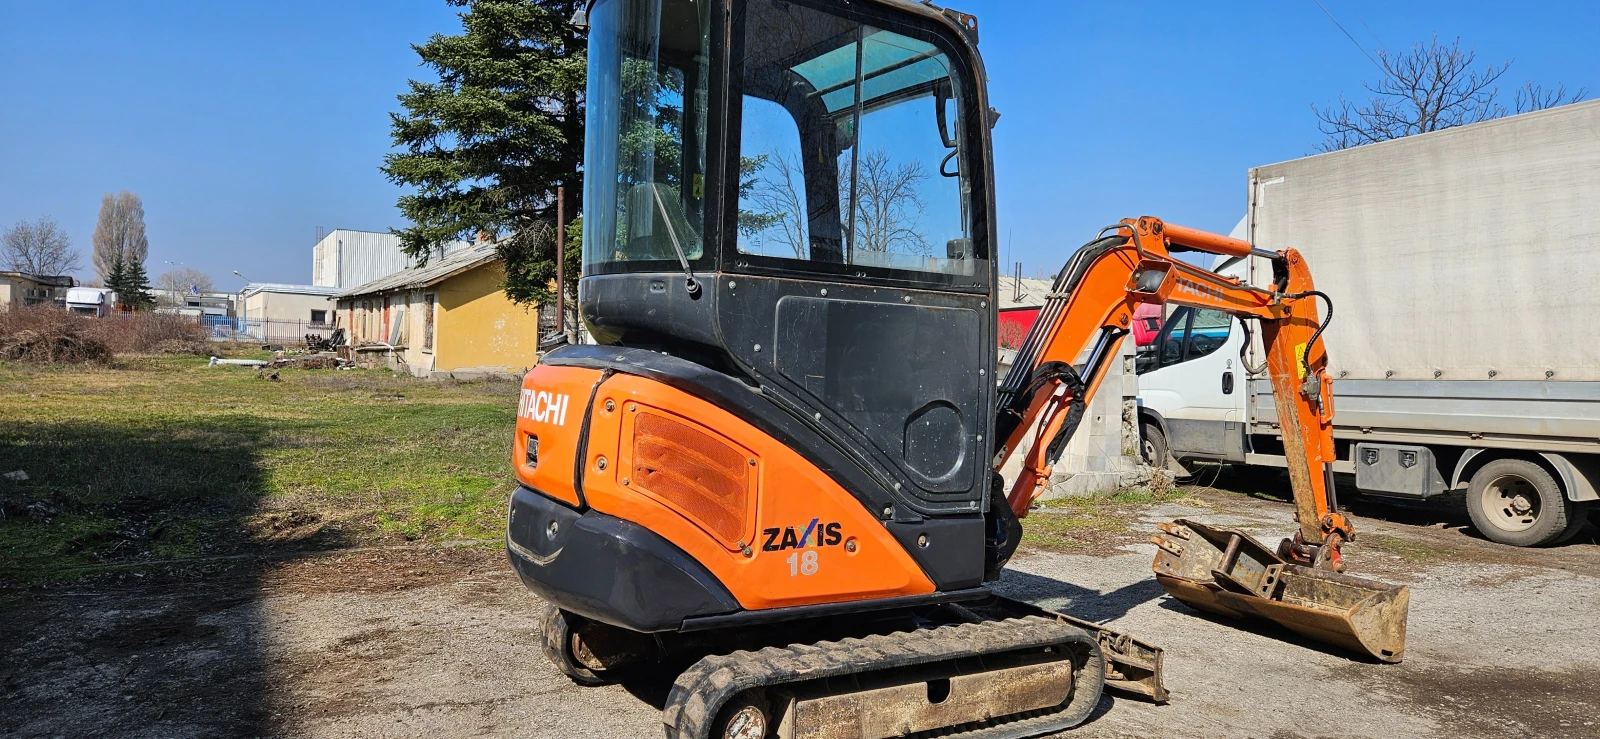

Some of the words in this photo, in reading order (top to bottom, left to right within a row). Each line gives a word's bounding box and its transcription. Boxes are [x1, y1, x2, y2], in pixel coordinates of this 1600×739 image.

[1177, 278, 1223, 302] TACHI
[762, 518, 842, 552] ZAXIS
[786, 550, 819, 577] 18
